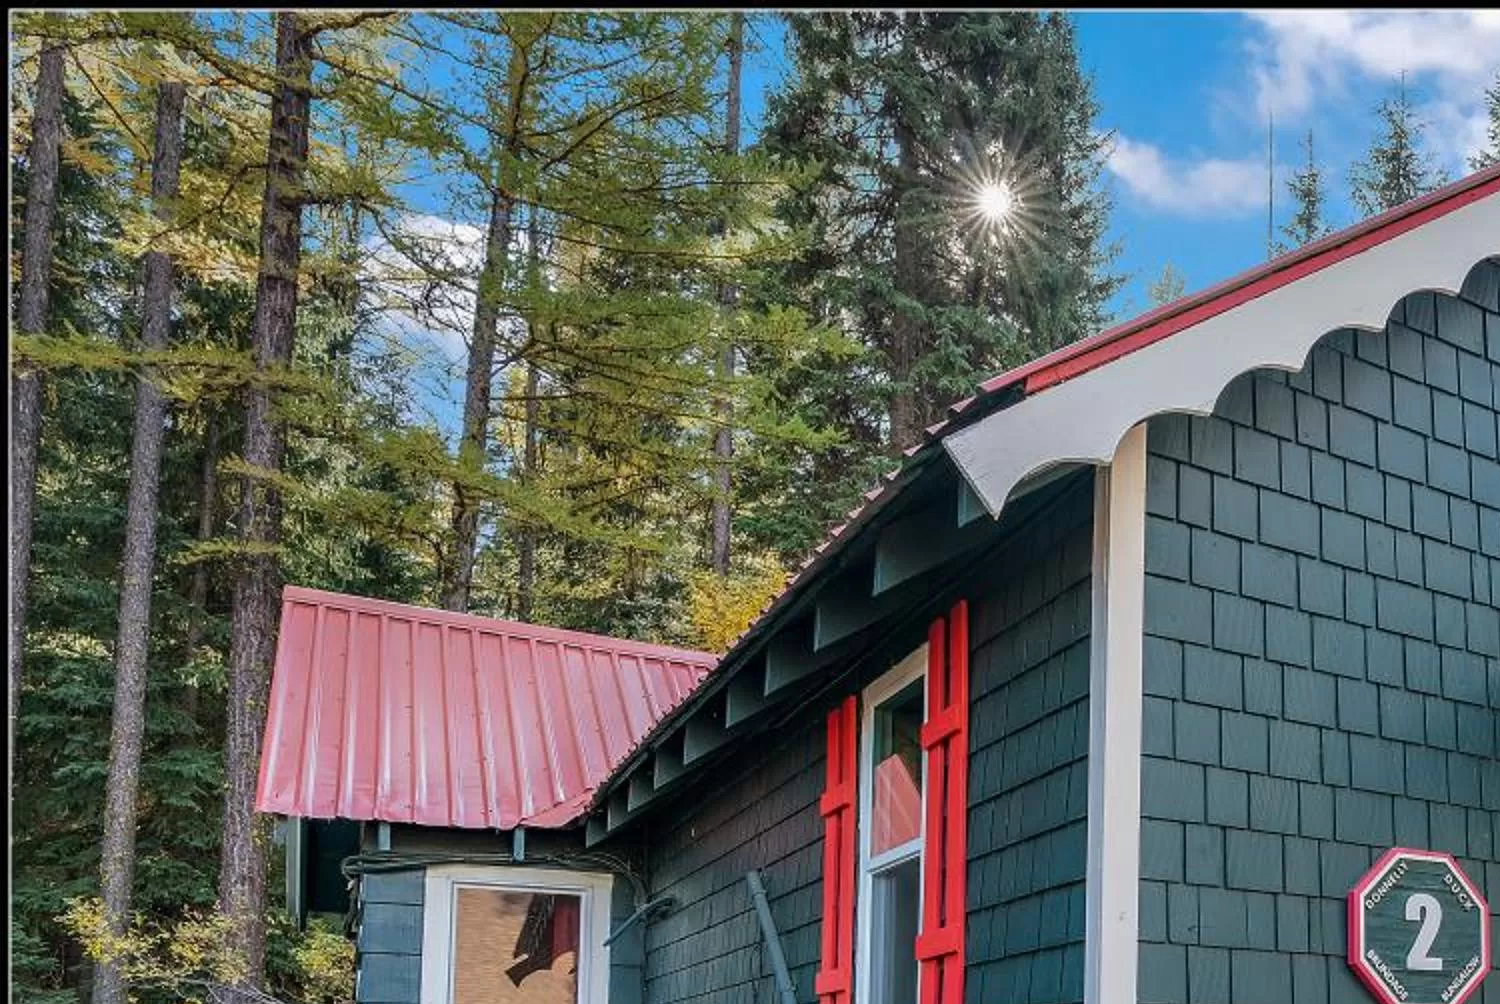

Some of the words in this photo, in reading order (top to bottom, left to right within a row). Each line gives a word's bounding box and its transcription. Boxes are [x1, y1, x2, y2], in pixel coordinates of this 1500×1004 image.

[1365, 860, 1409, 910] DONNELLY
[1443, 874, 1476, 911] DUCK
[1405, 893, 1443, 971] 2
[1366, 949, 1409, 1001] BRUNDAGE
